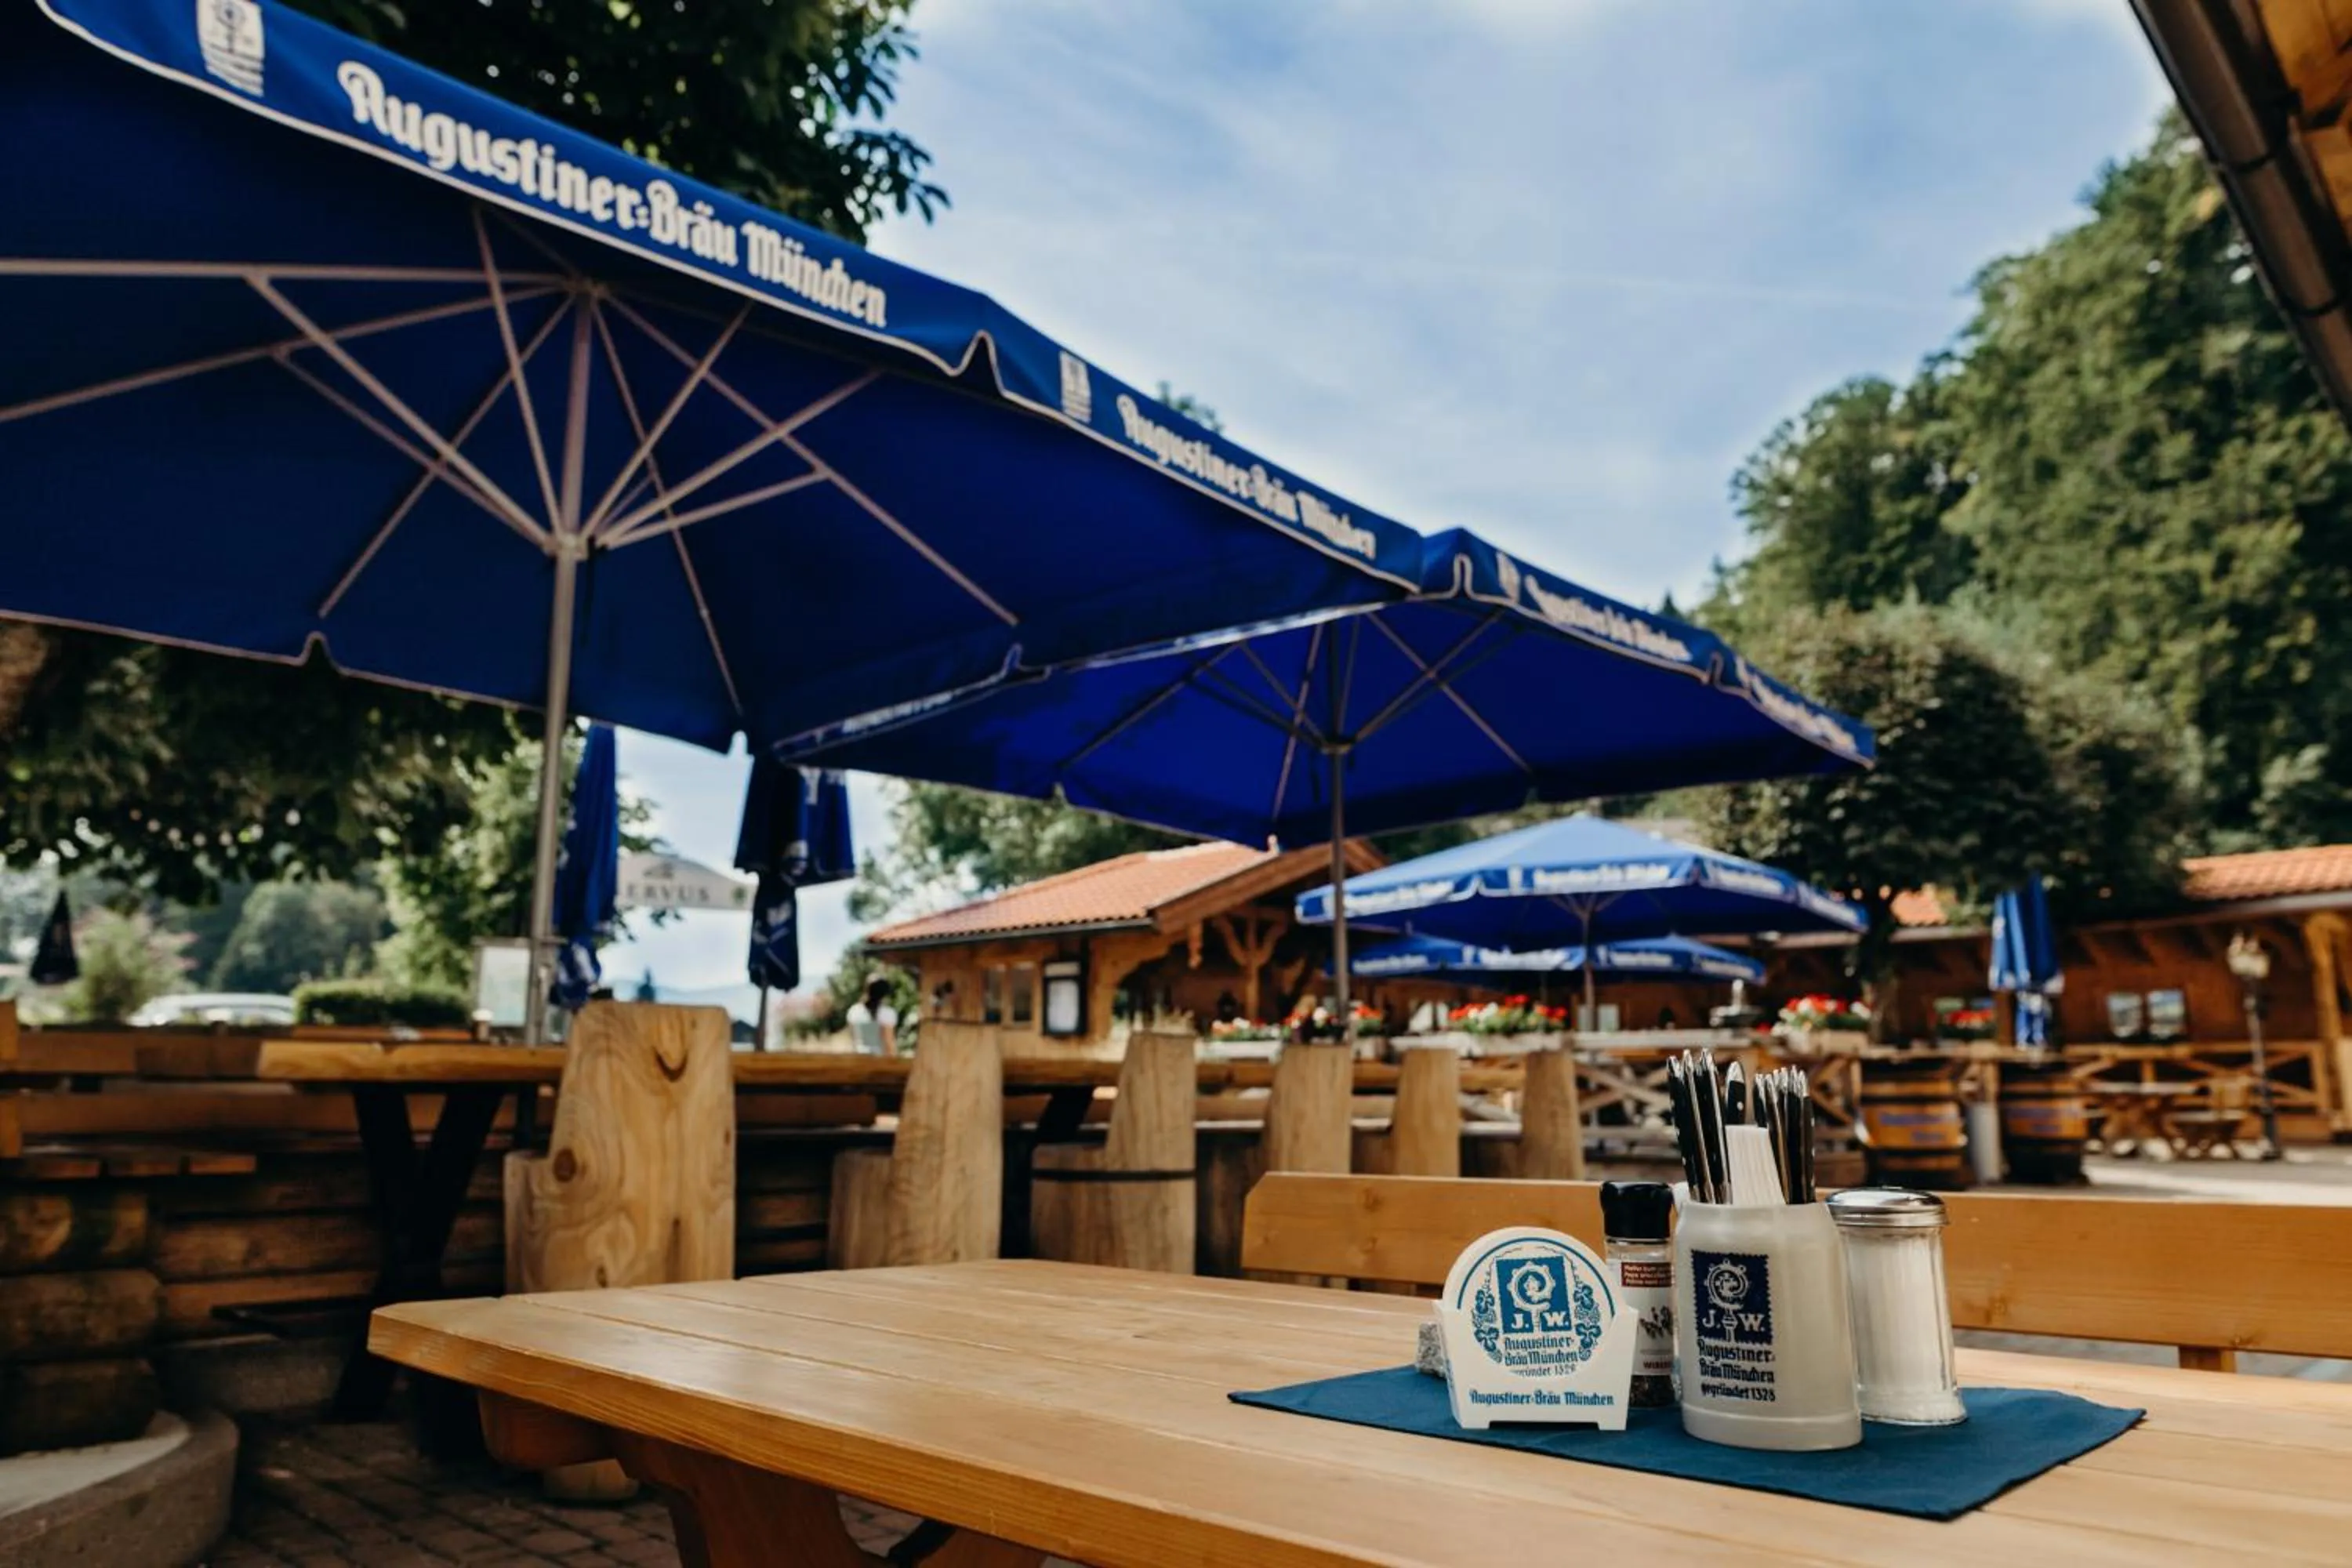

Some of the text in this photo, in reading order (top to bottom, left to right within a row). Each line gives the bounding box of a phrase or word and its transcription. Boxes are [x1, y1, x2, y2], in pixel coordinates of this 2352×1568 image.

[741, 220, 887, 328] München
[626, 884, 710, 902] ERVUS
[1563, 1391, 1614, 1406] München
